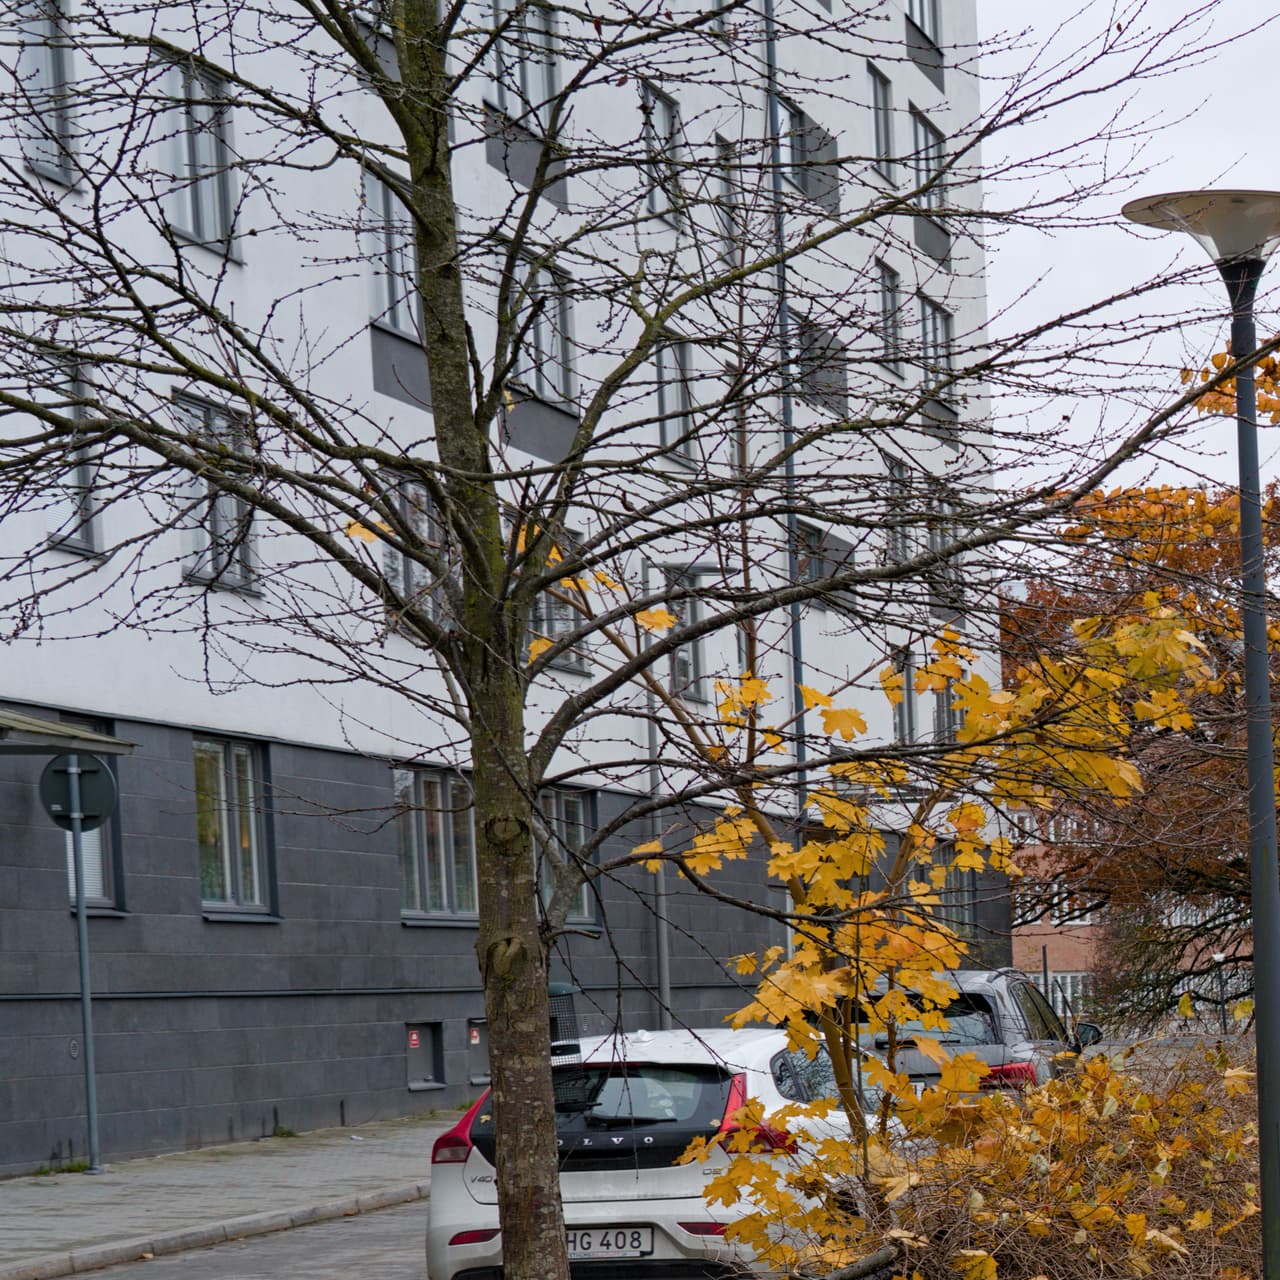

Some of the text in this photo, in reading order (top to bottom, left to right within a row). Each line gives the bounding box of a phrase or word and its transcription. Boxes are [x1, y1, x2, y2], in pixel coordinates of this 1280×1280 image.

[557, 1136, 654, 1147] OLVO
[566, 1230, 642, 1251] HG 408
